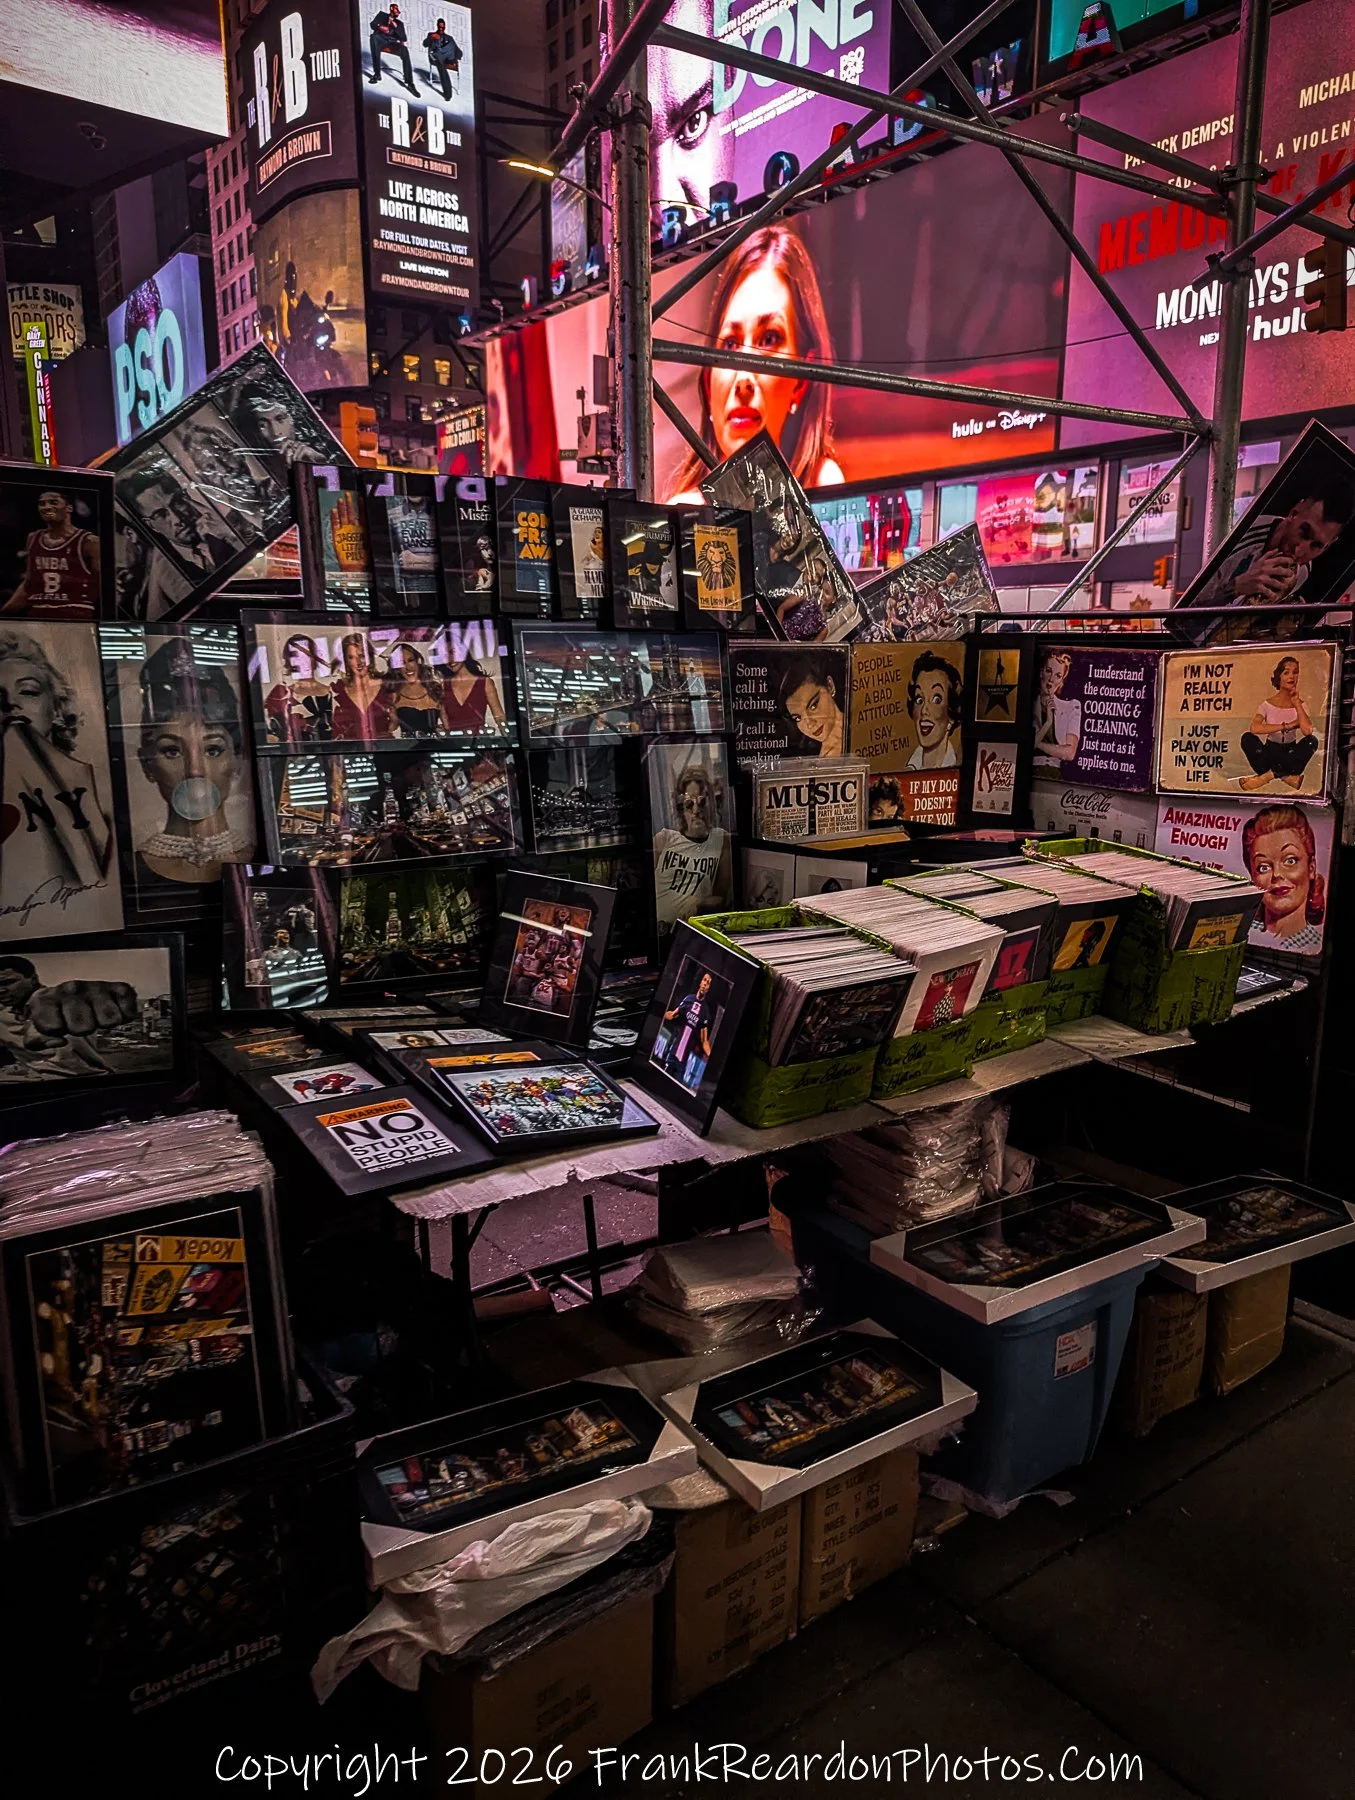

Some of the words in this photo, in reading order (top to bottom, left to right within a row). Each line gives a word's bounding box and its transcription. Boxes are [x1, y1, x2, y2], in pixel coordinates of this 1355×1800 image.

[310, 49, 340, 81] TOUR
[1300, 71, 1355, 108] MICHA
[378, 114, 390, 129] THE
[446, 130, 462, 146] TOUR
[259, 149, 282, 185] RAYMOND
[287, 131, 321, 161] BROWN
[1276, 143, 1284, 159] A
[392, 151, 423, 168] RAYMOND
[430, 160, 452, 175] BROWN
[388, 180, 414, 201] LIVE
[415, 186, 459, 211] ACROSS
[379, 198, 417, 222] NORTH
[419, 206, 469, 233] AMERICA
[380, 229, 395, 241] FOR
[395, 232, 411, 244] FULL
[411, 235, 429, 247] TOUR
[429, 239, 451, 254] DATES,
[451, 243, 468, 256] VISIT
[373, 239, 474, 268] RAYMONDANDBROWNTOUR.COM
[400, 261, 417, 272] LIVE
[418, 264, 449, 278] NATION
[381, 274, 470, 298] #RAYMONDANDBROWNTOUR
[43, 287, 75, 311] SHOP
[952, 418, 983, 438] hulu
[986, 420, 996, 429] on
[998, 410, 1046, 430] Disney+
[401, 529, 426, 539] EVAN
[402, 521, 427, 530] DEAR
[41, 556, 69, 572] NBA
[43, 572, 61, 593] 8
[736, 663, 768, 677] Some
[858, 655, 893, 674] PEOPLE
[1088, 664, 1093, 678] I
[1094, 665, 1144, 681] understand
[1183, 664, 1201, 679] I'M
[1205, 664, 1233, 678] NOT
[735, 680, 755, 694] call
[759, 680, 768, 693] it
[852, 676, 870, 692] SAY
[871, 674, 875, 686] I
[877, 669, 901, 685] HAVE
[1184, 681, 1231, 695] REALLY
[864, 693, 872, 706] A
[873, 688, 892, 703] BAD
[1084, 681, 1098, 695] the
[1099, 685, 1134, 702] concept
[1136, 685, 1147, 699] of
[1084, 700, 1131, 718] COOKING
[1132, 704, 1142, 718] &
[1180, 698, 1189, 712] A
[1193, 698, 1232, 711] BITCH
[746, 721, 765, 735] call
[768, 721, 776, 734] it
[869, 730, 873, 741] I
[874, 726, 893, 741] SAY
[1084, 718, 1138, 737] CLEANING,
[1180, 726, 1184, 737] I
[1188, 725, 1219, 738] JUST
[1081, 736, 1099, 751] Just
[1100, 741, 1116, 753] not
[1117, 743, 1127, 755] as
[1128, 741, 1136, 755] it
[1171, 740, 1200, 753] PLAY
[1203, 741, 1229, 753] ONE
[1077, 755, 1108, 771] applies
[1110, 759, 1119, 771] to
[1120, 763, 1136, 774] me.
[1174, 755, 1186, 767] IN
[1191, 755, 1223, 769] YOUR
[1186, 770, 1210, 782] LIFE
[766, 780, 857, 809] MUSIC
[909, 781, 919, 795] IF
[921, 780, 937, 793] MY
[939, 778, 958, 793] DOG
[18, 787, 89, 833] NY
[1163, 806, 1241, 832] AMAZINGLY
[1171, 828, 1228, 851] ENOUGH
[661, 850, 690, 873] NEW
[670, 869, 705, 896] CITY
[345, 1102, 408, 1120] WARNING
[331, 1112, 424, 1146] NO
[350, 1130, 438, 1156] STUPID
[358, 1139, 450, 1167] PEOPLE
[367, 1161, 405, 1173] BEYOND
[407, 1155, 428, 1165] THIS
[428, 1149, 455, 1159] POINT
[175, 1238, 235, 1257] Kodak
